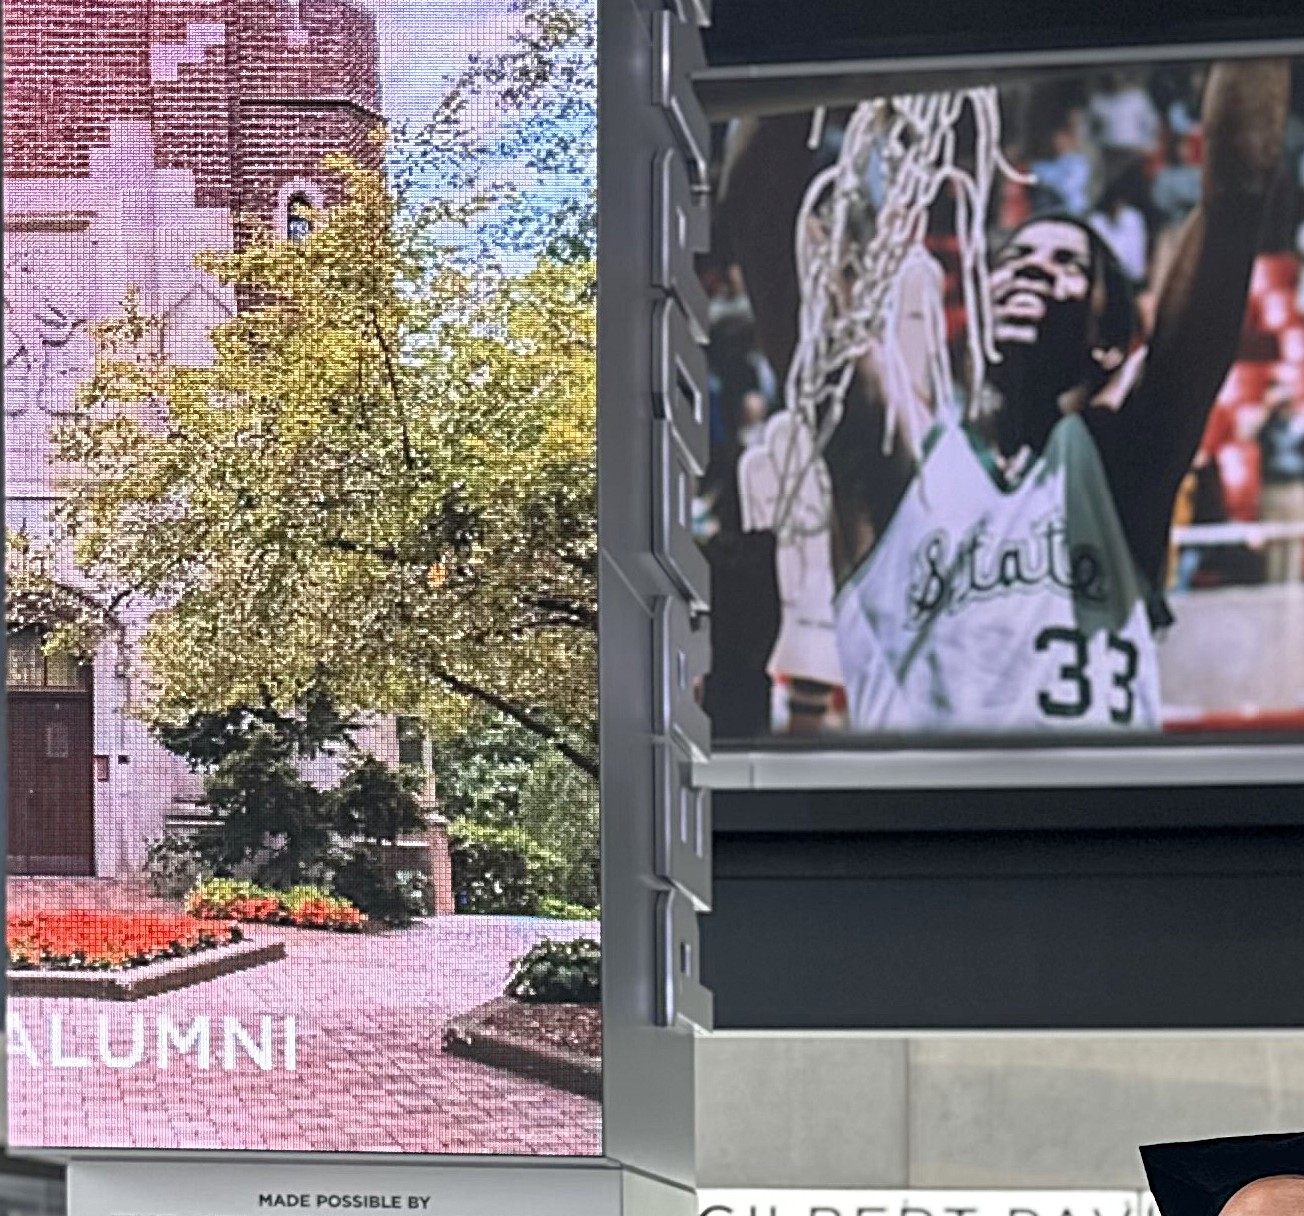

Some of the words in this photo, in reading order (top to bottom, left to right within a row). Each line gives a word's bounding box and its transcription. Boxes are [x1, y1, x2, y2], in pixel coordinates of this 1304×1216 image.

[909, 514, 1102, 616] State
[1034, 626, 1138, 724] 33
[7, 1012, 299, 1071] ALUMNI
[258, 1194, 311, 1207] MADE
[316, 1194, 402, 1209] POSSIBLE
[408, 1196, 431, 1210] BY
